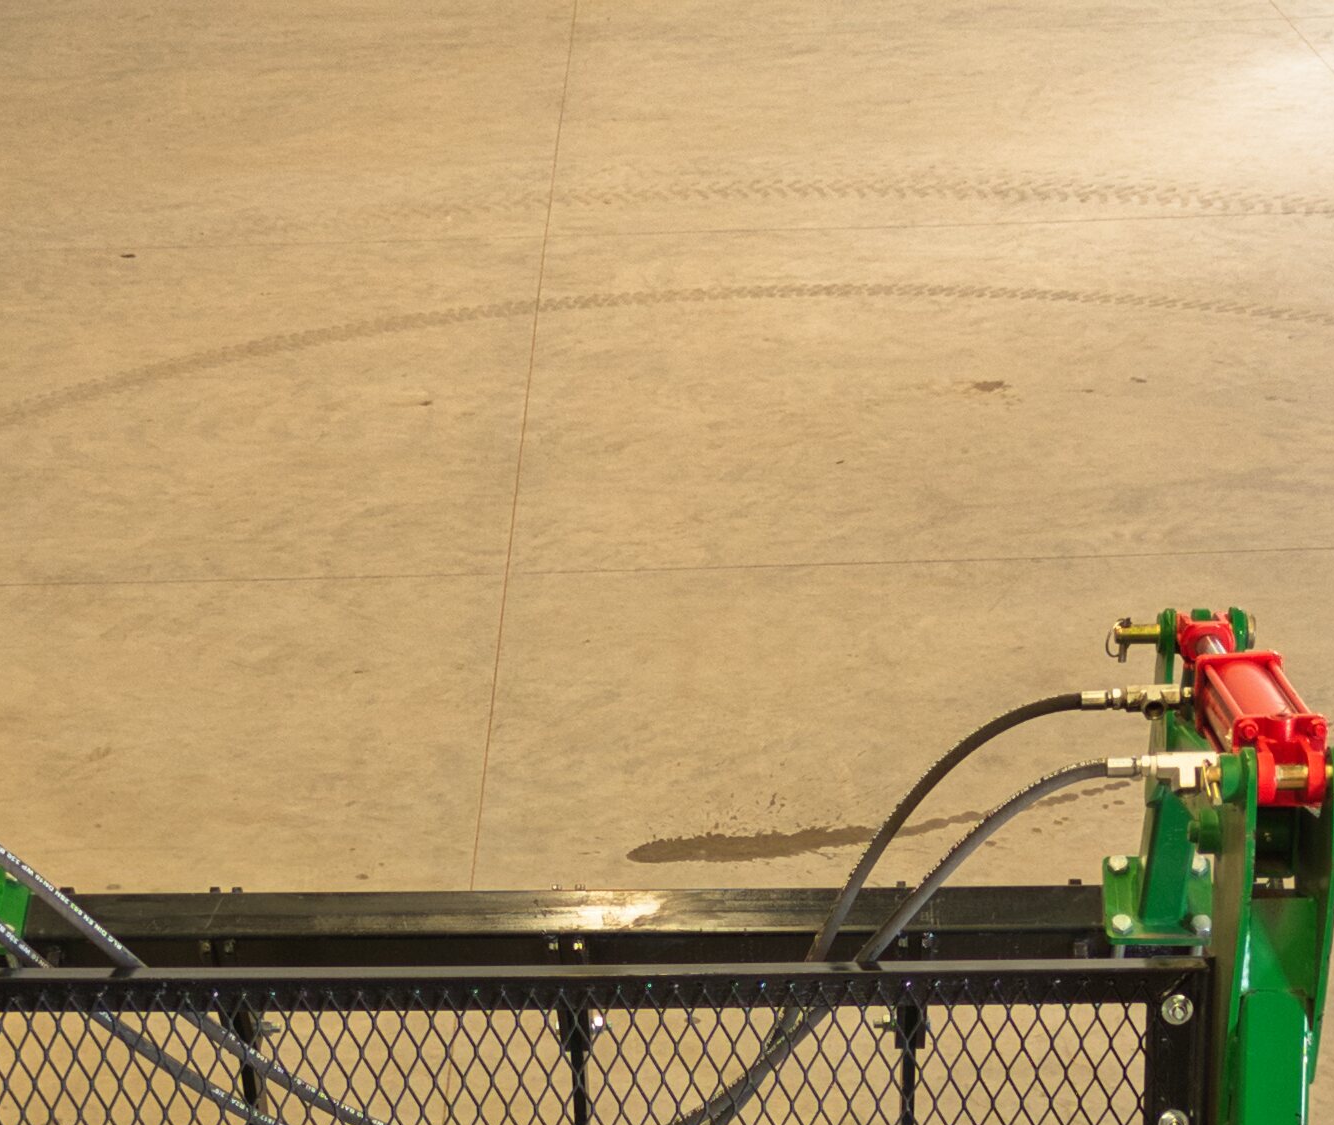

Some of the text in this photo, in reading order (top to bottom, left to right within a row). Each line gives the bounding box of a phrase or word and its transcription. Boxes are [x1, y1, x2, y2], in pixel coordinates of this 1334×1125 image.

[7, 852, 21, 865] 330
[21, 864, 34, 876] WP
[83, 914, 95, 926] EN
[92, 923, 108, 937] DIN
[5, 931, 20, 945] 330
[18, 943, 31, 956] WP
